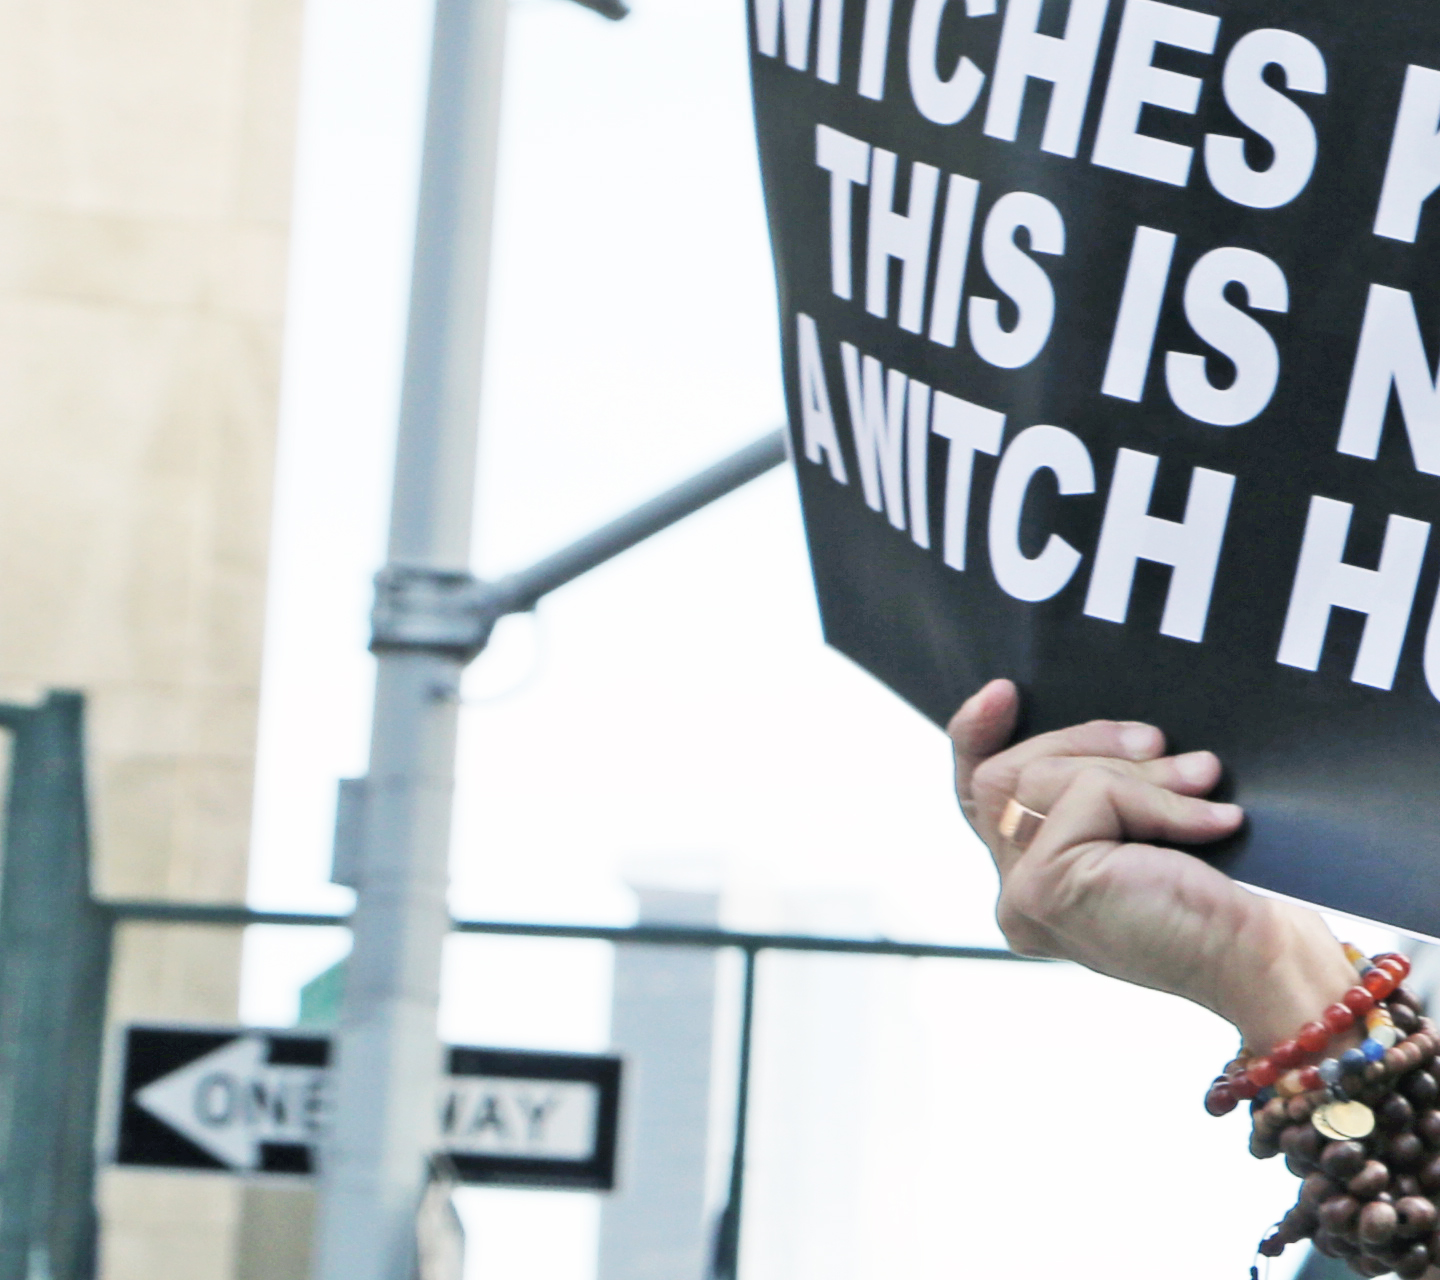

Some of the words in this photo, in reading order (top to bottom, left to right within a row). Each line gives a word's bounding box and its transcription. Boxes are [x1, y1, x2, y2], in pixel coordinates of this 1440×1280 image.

[816, 124, 1065, 369] THIS
[1102, 226, 1288, 426] IS
[798, 313, 846, 483] A
[841, 342, 1236, 643] WITCH
[192, 1072, 336, 1131] ONE
